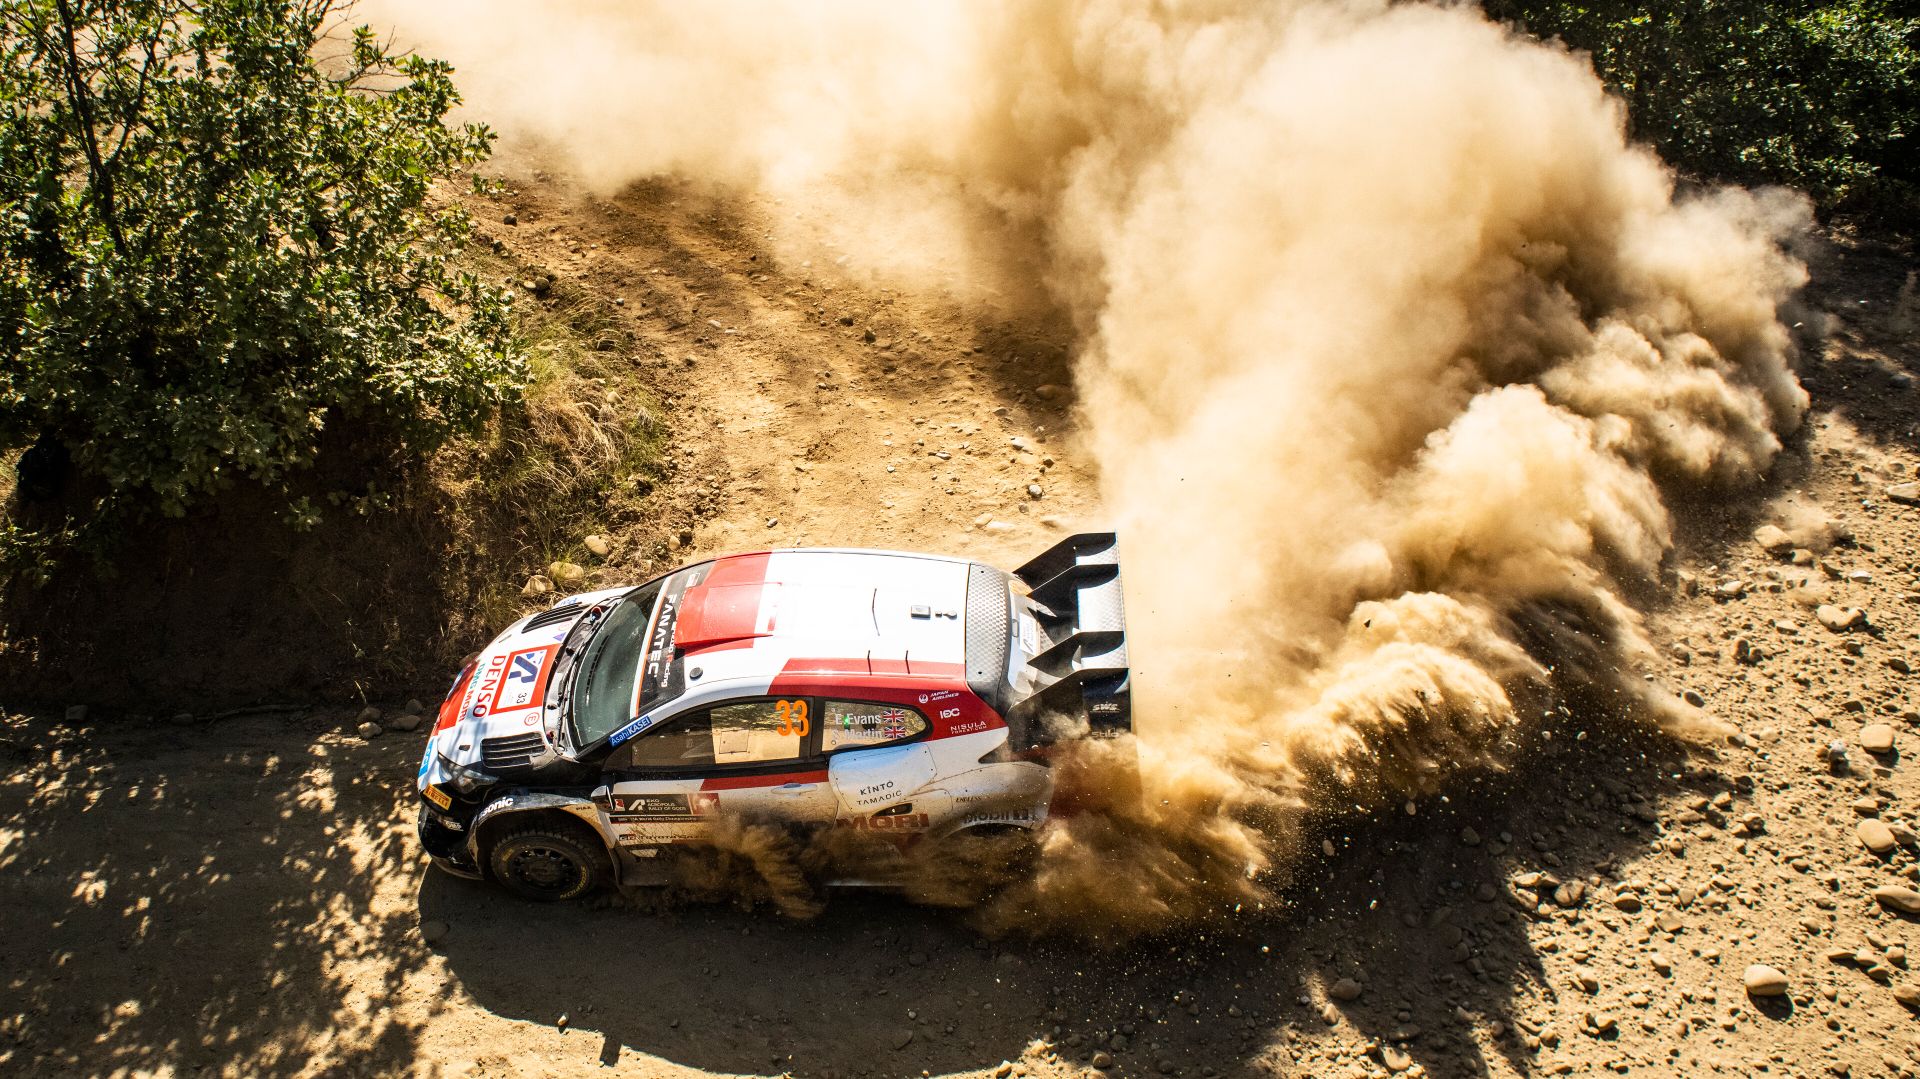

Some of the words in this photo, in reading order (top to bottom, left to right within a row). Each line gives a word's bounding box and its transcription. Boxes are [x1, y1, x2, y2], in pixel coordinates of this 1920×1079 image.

[648, 594, 677, 677] FANATEC
[472, 655, 507, 718] DENSO
[516, 692, 528, 704] 33
[930, 690, 949, 698] JAPAN
[932, 692, 960, 701] AIRLINES
[458, 689, 474, 722] MORI
[775, 699, 809, 737] 33
[846, 713, 881, 725] Evans
[611, 716, 650, 747] AsahiKASEI
[950, 720, 986, 731] NISULA
[844, 728, 882, 740] Martin
[857, 790, 902, 806] TAMADIC
